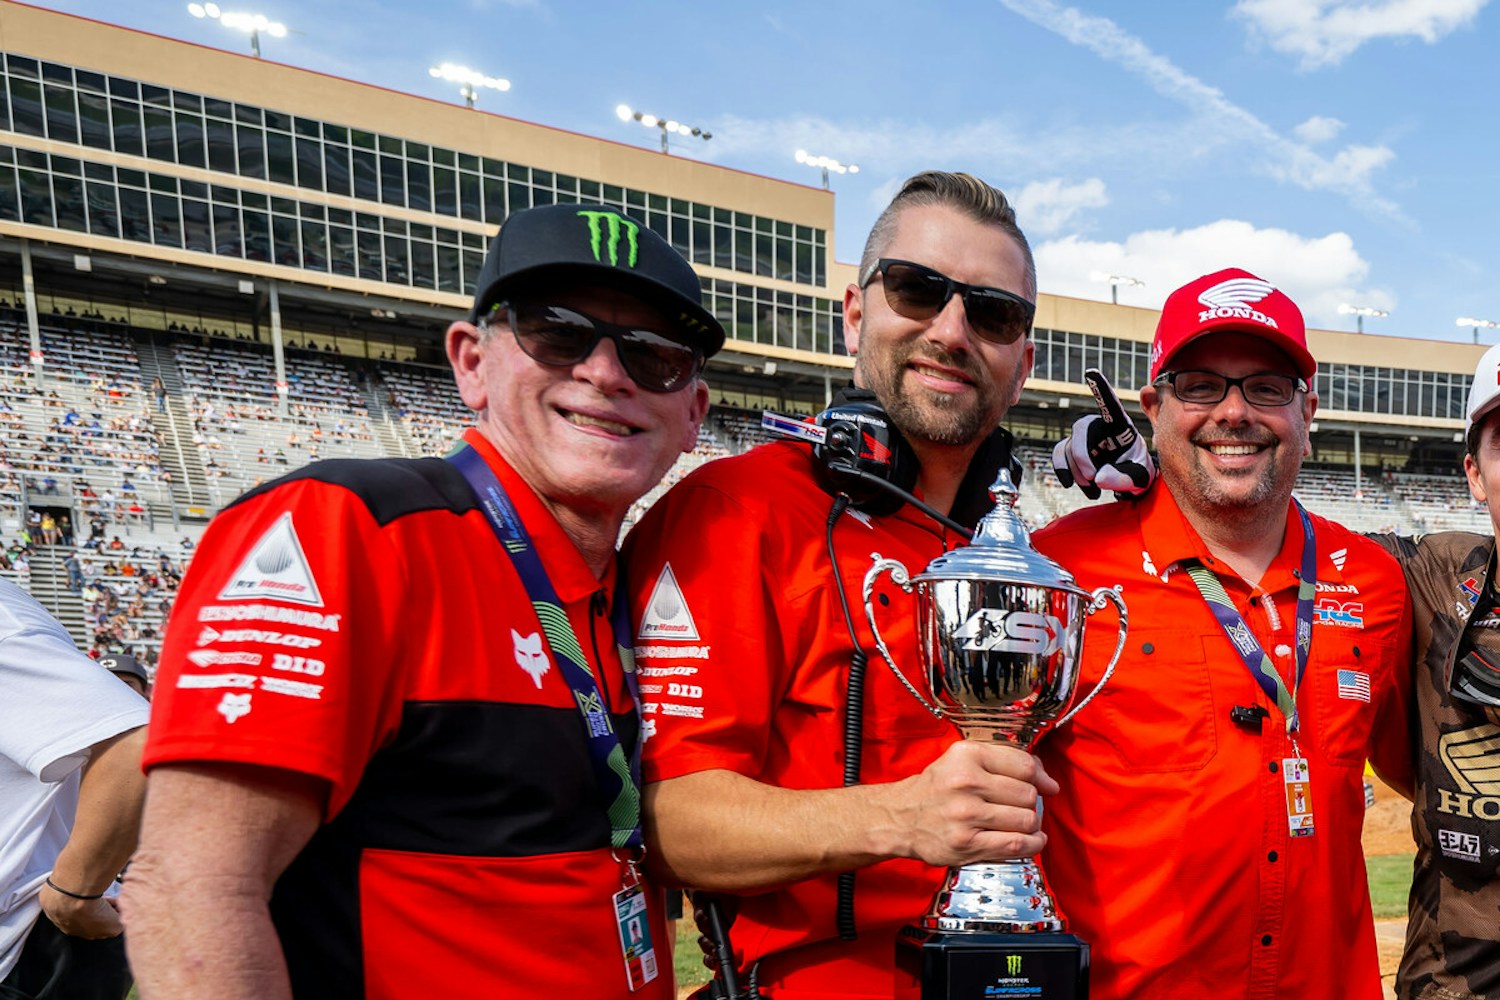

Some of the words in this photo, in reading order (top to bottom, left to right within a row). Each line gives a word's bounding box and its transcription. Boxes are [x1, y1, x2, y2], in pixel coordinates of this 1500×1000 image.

[1198, 306, 1279, 330] HONDA
[1314, 582, 1360, 595] ONDA
[218, 629, 323, 649] DUNLOP
[271, 653, 327, 677] DID
[642, 665, 699, 678] DUNLOP
[667, 682, 703, 699] DID
